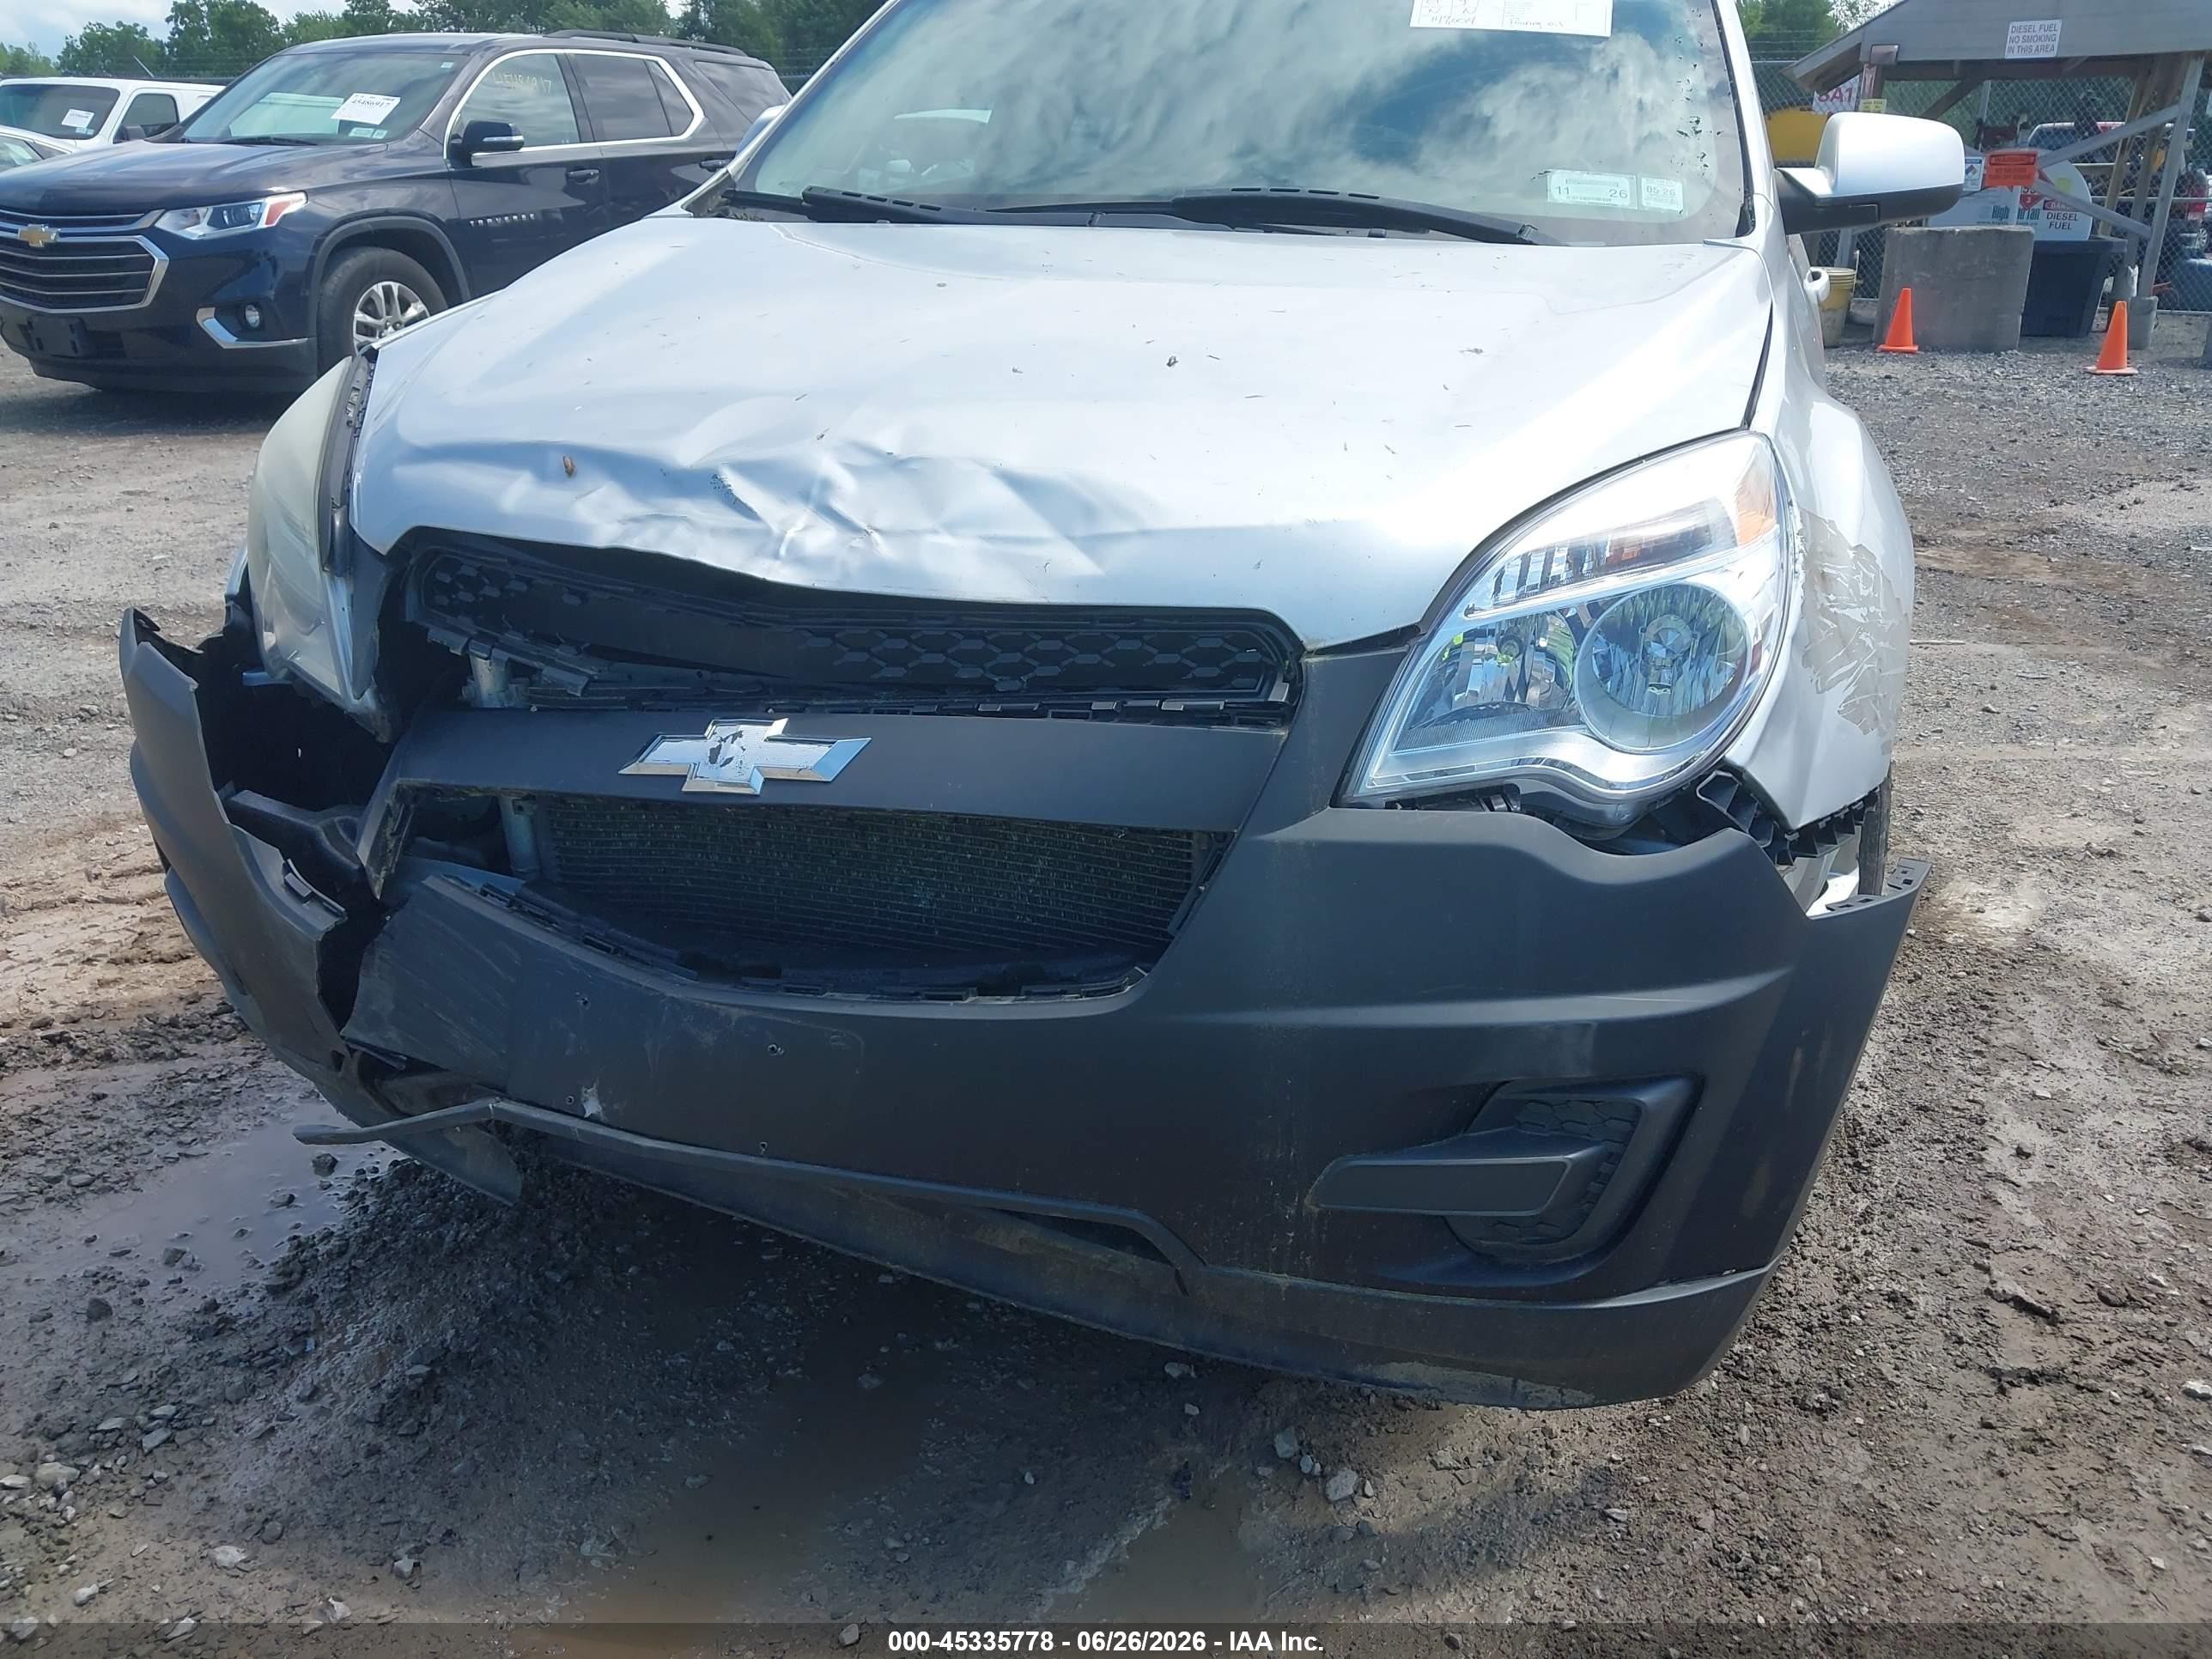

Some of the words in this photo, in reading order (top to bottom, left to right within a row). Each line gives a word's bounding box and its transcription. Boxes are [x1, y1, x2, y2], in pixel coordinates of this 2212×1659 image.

[2011, 24, 2036, 33] DIESEL
[2039, 23, 2057, 32] FUEL
[2009, 35, 2020, 44] NO
[2021, 34, 2057, 43] SMOKING
[2007, 46, 2014, 54] IN
[2017, 45, 2033, 53] THIS
[2034, 44, 2055, 52] AREA
[1554, 185, 1570, 195] 11
[1608, 188, 1628, 198] 26
[1662, 188, 1676, 197] 26
[469, 213, 535, 227] TRAVERSE
[2046, 211, 2079, 221] DIESEL
[2049, 222, 2072, 230] FUEL
